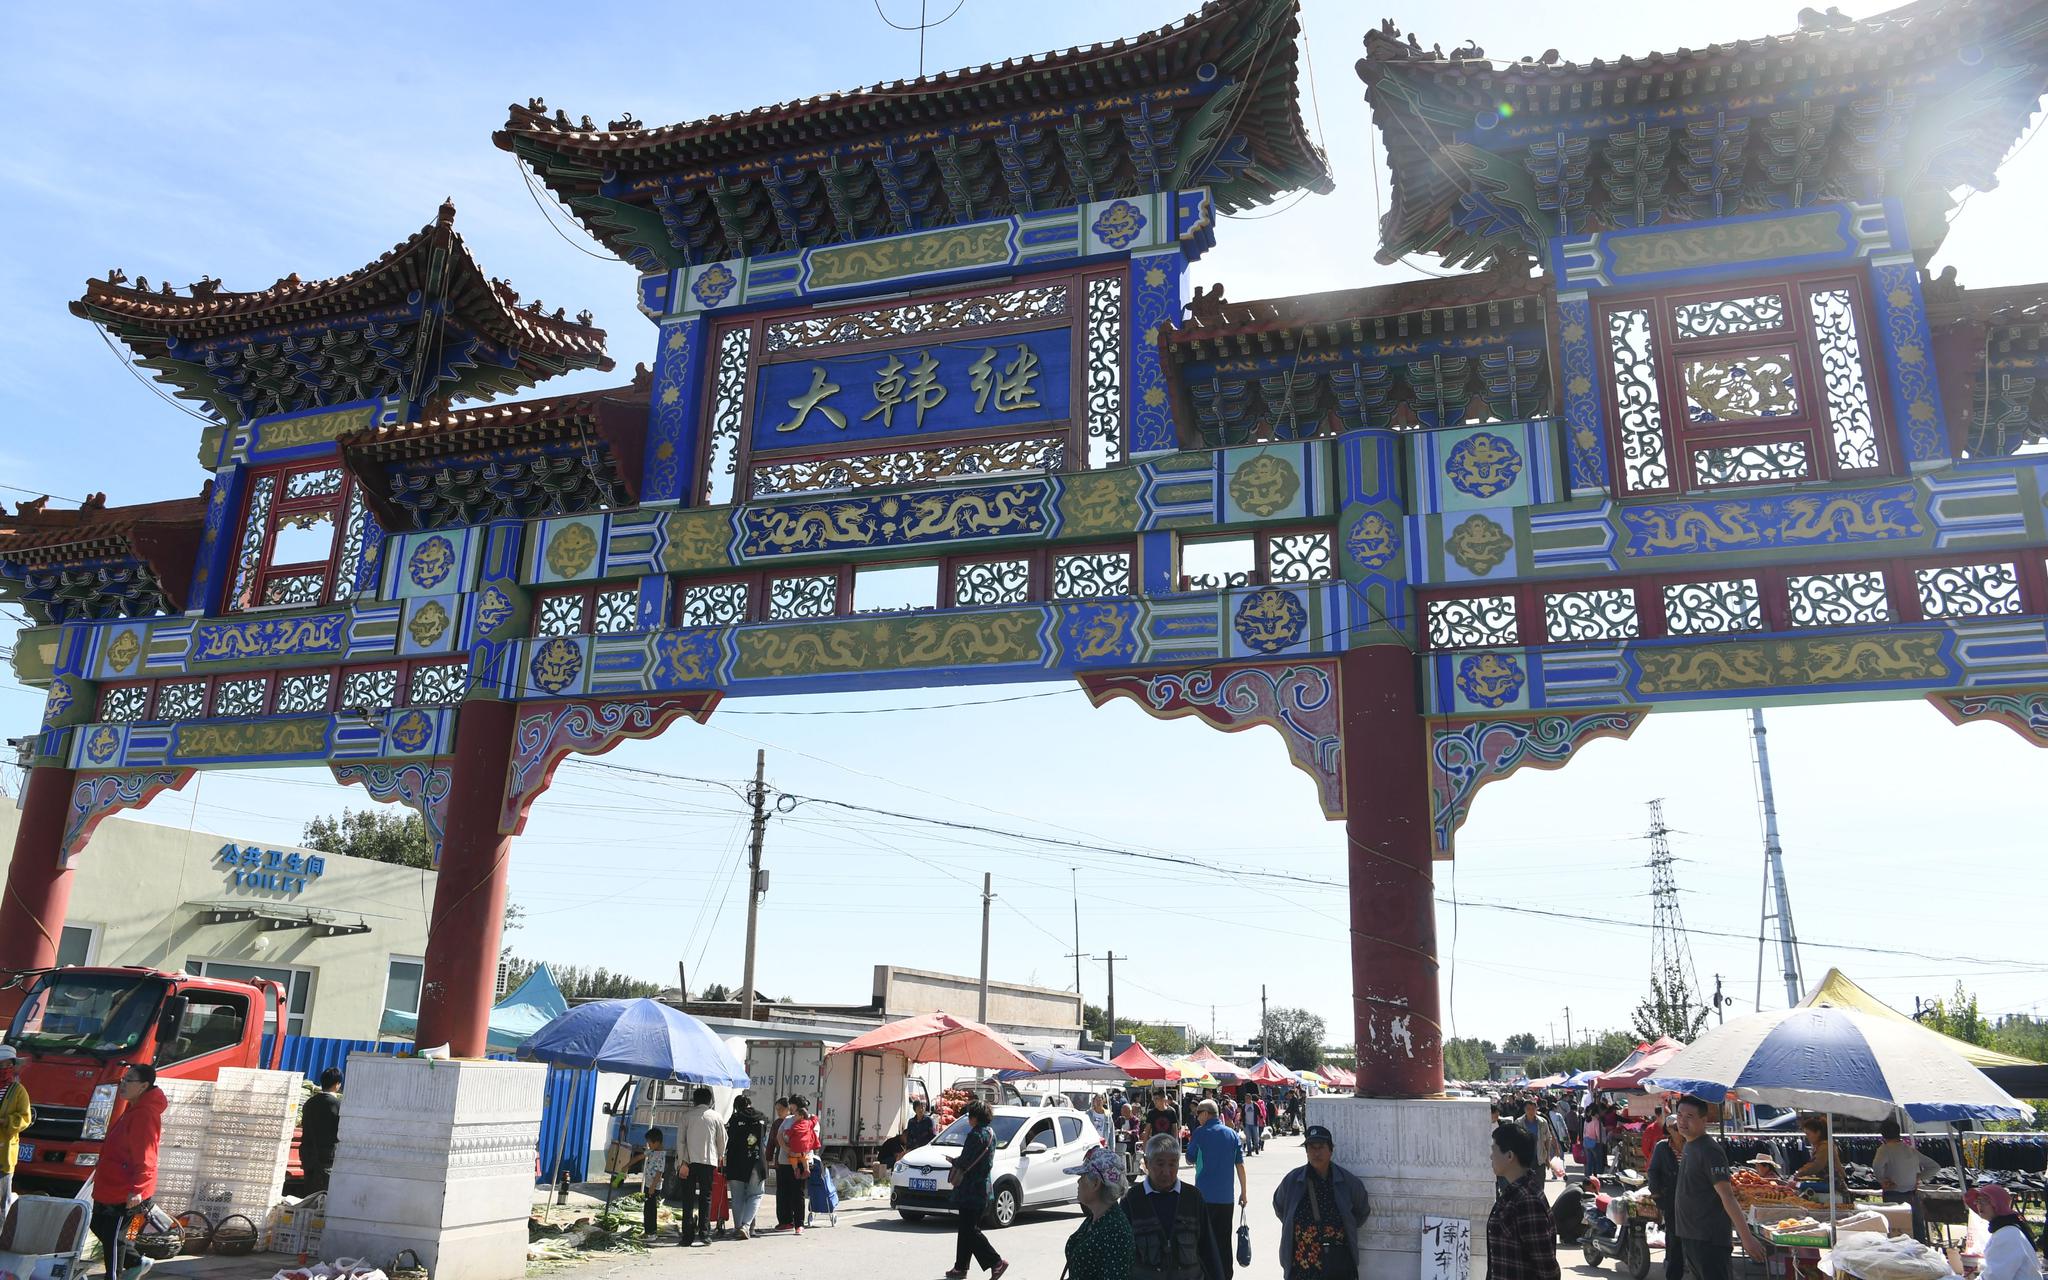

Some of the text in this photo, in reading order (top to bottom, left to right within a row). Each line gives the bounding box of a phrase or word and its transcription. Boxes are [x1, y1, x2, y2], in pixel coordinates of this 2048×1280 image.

[776, 343, 1041, 433] 大韩继
[220, 843, 326, 877] 公共卫生间
[235, 869, 307, 893] TOILET
